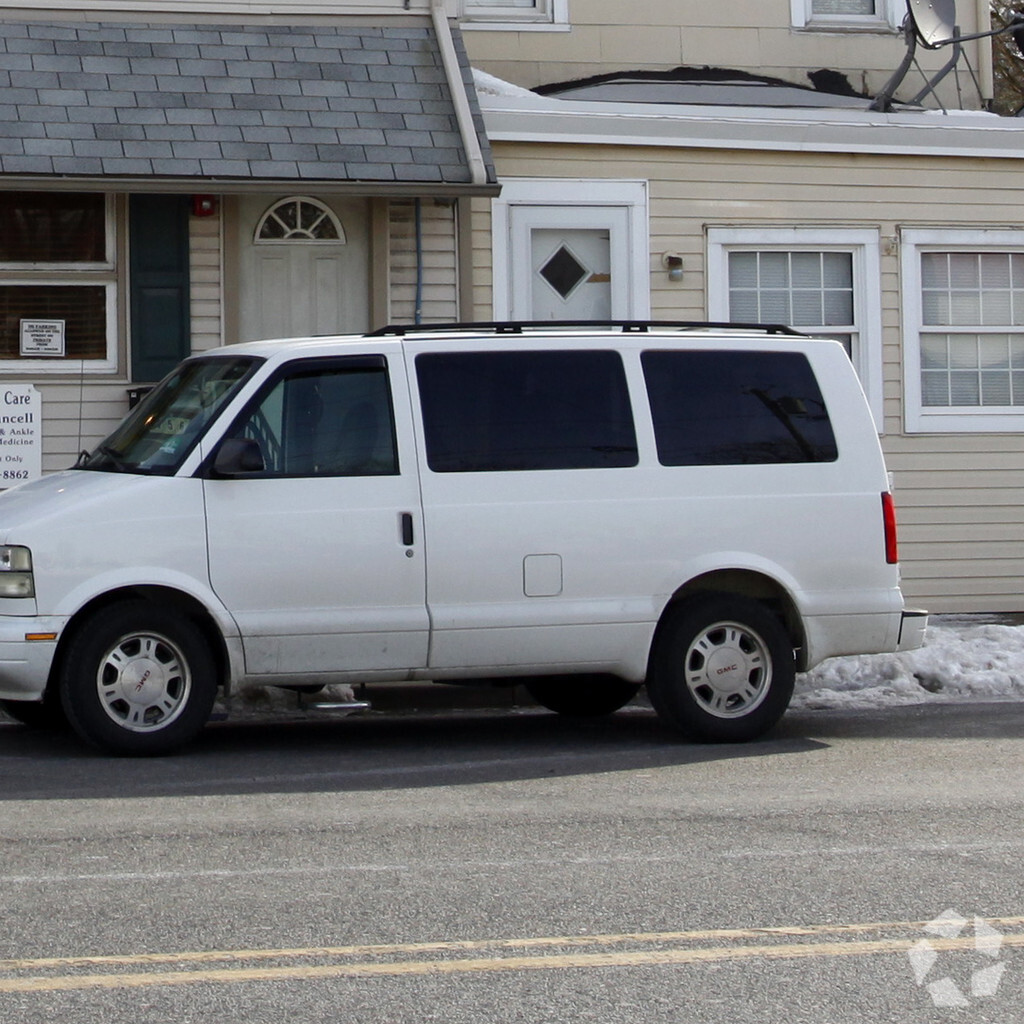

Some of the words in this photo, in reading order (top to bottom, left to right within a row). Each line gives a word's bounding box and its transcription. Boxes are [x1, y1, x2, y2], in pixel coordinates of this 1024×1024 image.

[4, 391, 30, 405] Care
[717, 664, 737, 675] GMC
[135, 670, 151, 692] GMC
